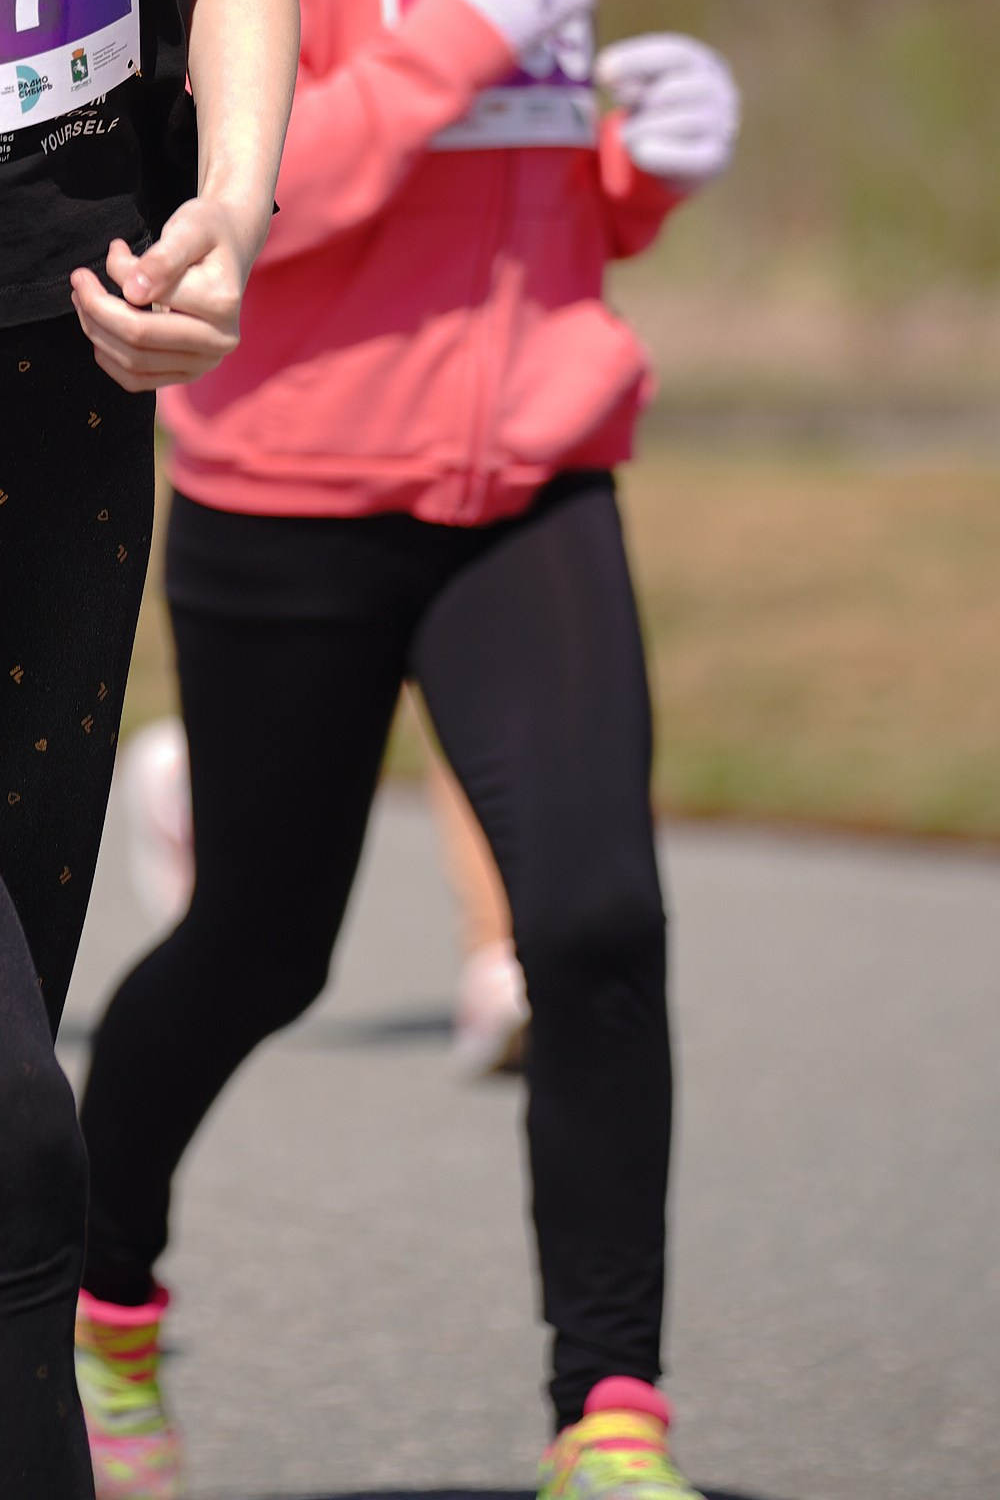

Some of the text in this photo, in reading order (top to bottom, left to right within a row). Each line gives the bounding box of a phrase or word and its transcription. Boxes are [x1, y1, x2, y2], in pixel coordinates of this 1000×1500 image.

[18, 75, 49, 91] РАДИО
[18, 83, 53, 99] СИБИРЬ
[41, 117, 120, 156] YOURSELF
